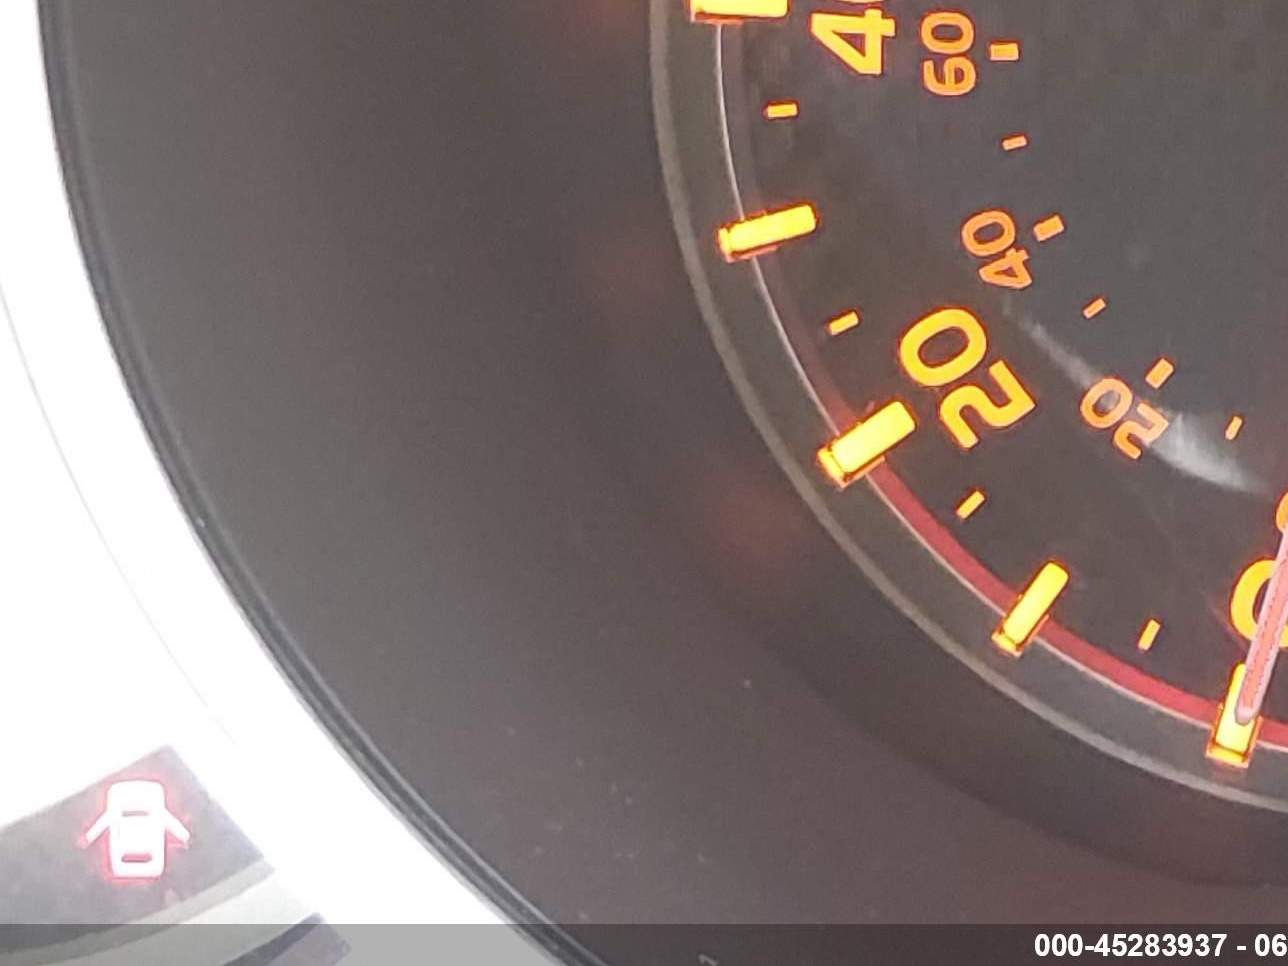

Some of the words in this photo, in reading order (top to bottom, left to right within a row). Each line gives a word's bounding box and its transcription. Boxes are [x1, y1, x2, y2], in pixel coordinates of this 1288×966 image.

[919, 10, 977, 96] 60
[960, 209, 1032, 289] 40
[898, 306, 1037, 449] 20
[1079, 377, 1169, 459] 20
